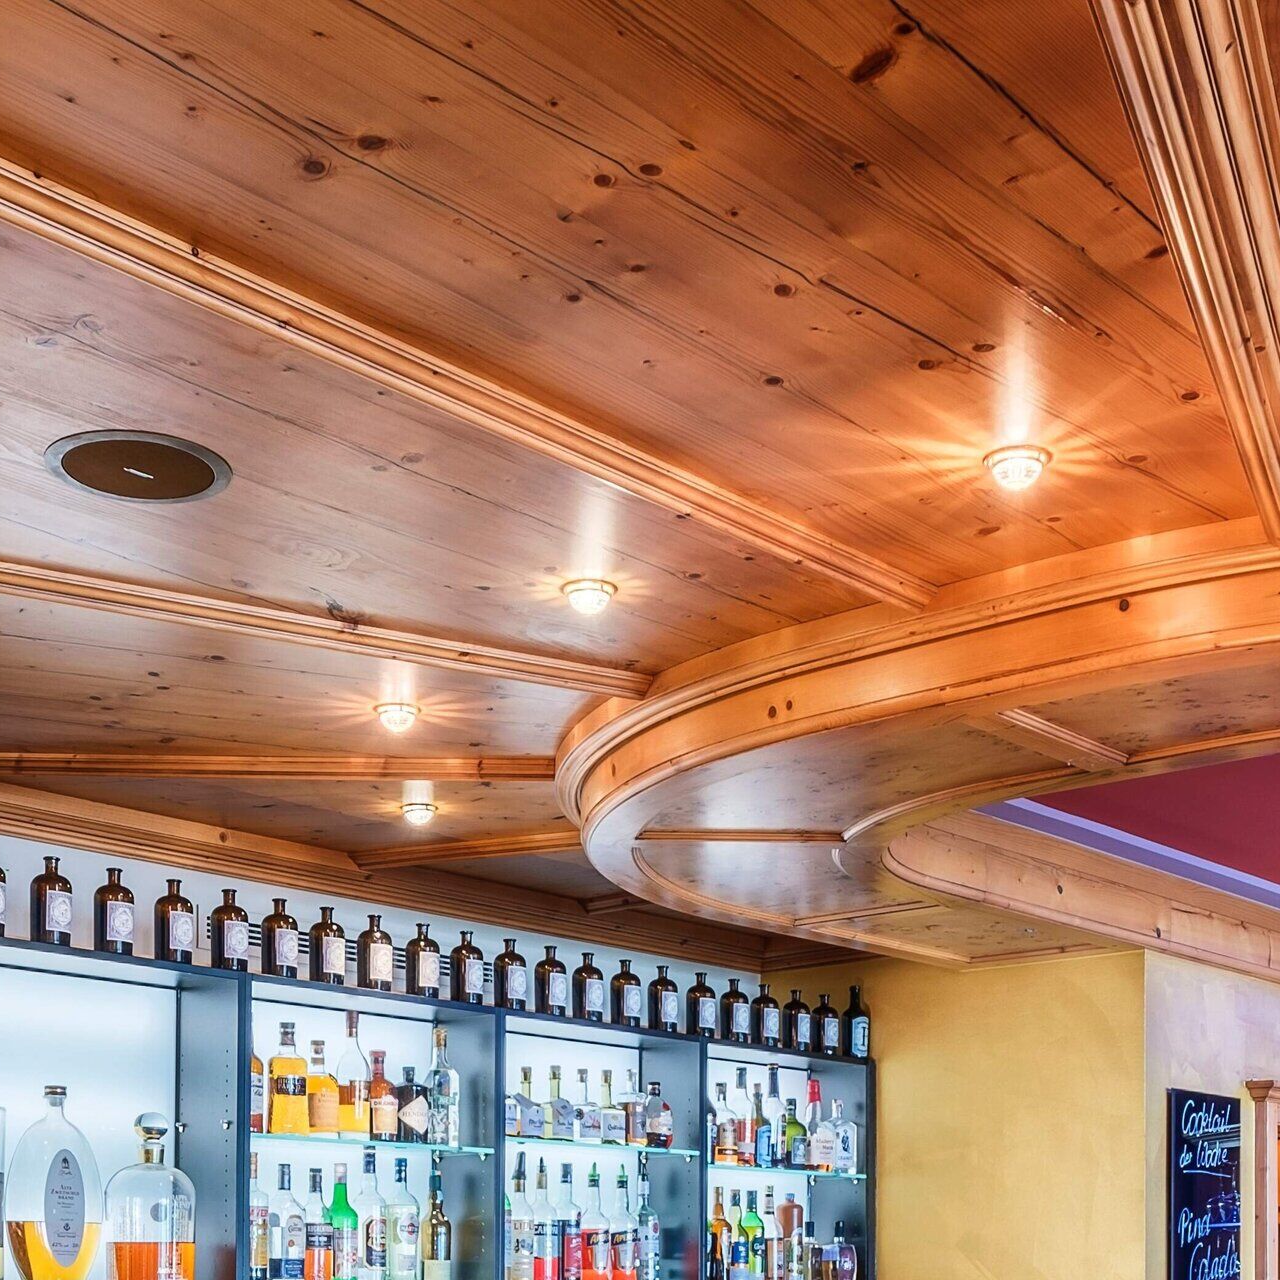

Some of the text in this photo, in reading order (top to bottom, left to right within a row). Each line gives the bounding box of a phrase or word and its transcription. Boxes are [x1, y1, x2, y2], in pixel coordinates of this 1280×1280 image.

[1182, 1100, 1231, 1137] Cocktail
[1180, 1140, 1229, 1168] der Woche
